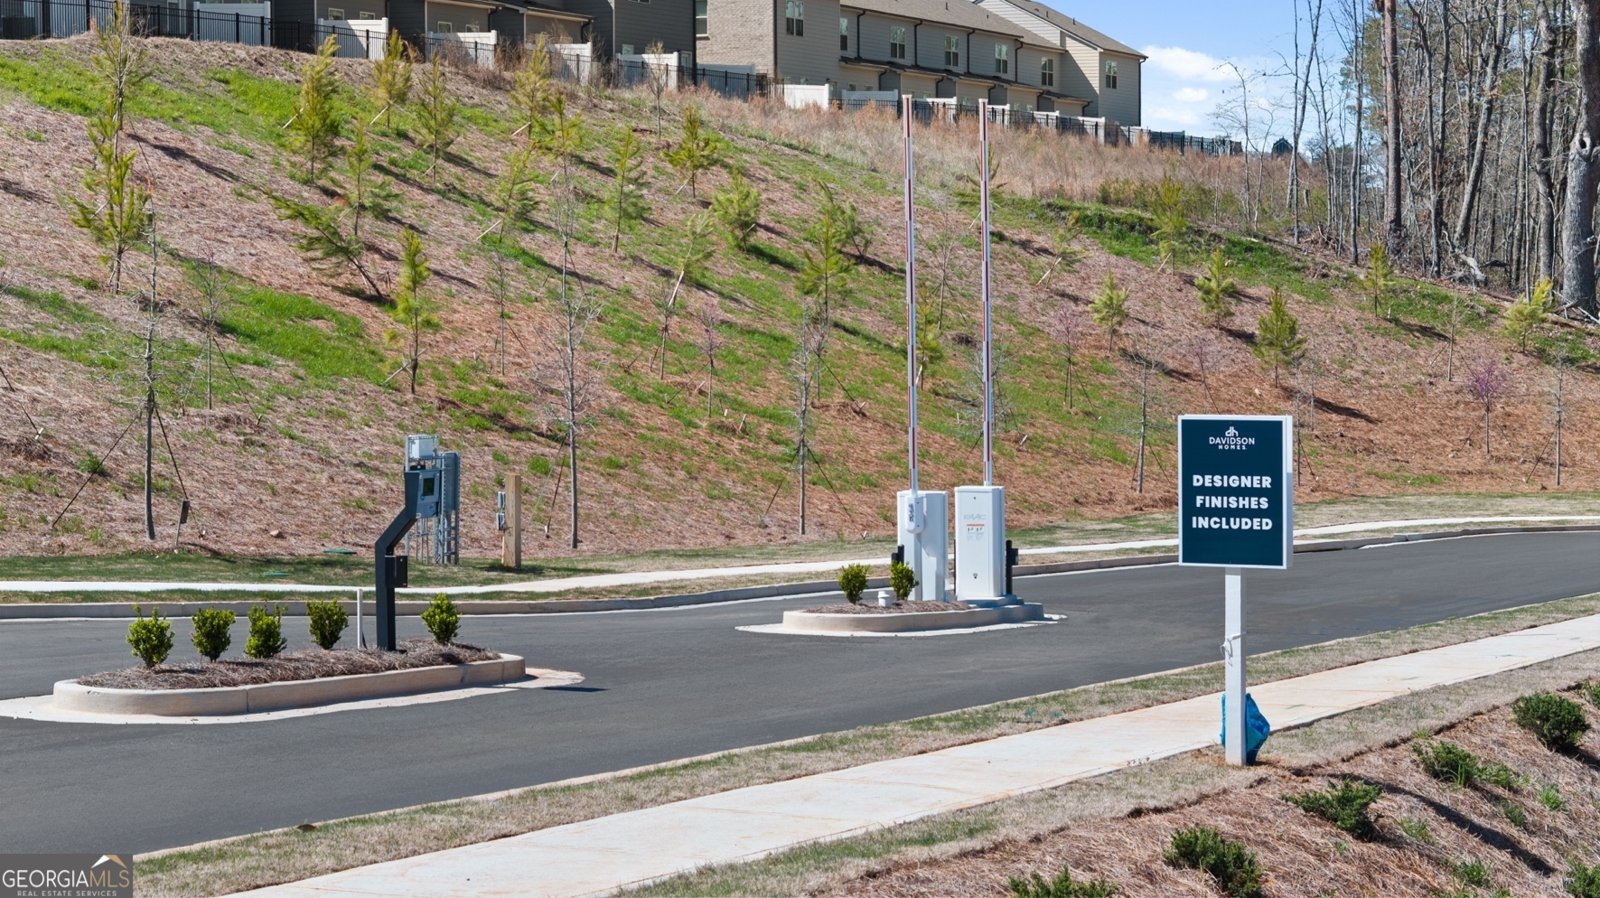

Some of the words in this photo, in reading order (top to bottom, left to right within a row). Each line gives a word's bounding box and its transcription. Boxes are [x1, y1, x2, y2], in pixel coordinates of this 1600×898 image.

[1209, 436, 1255, 445] DAVIDSON
[1192, 474, 1272, 488] DESIGNER
[1195, 495, 1269, 509] FINISHES
[1192, 516, 1273, 530] INCLUDED
